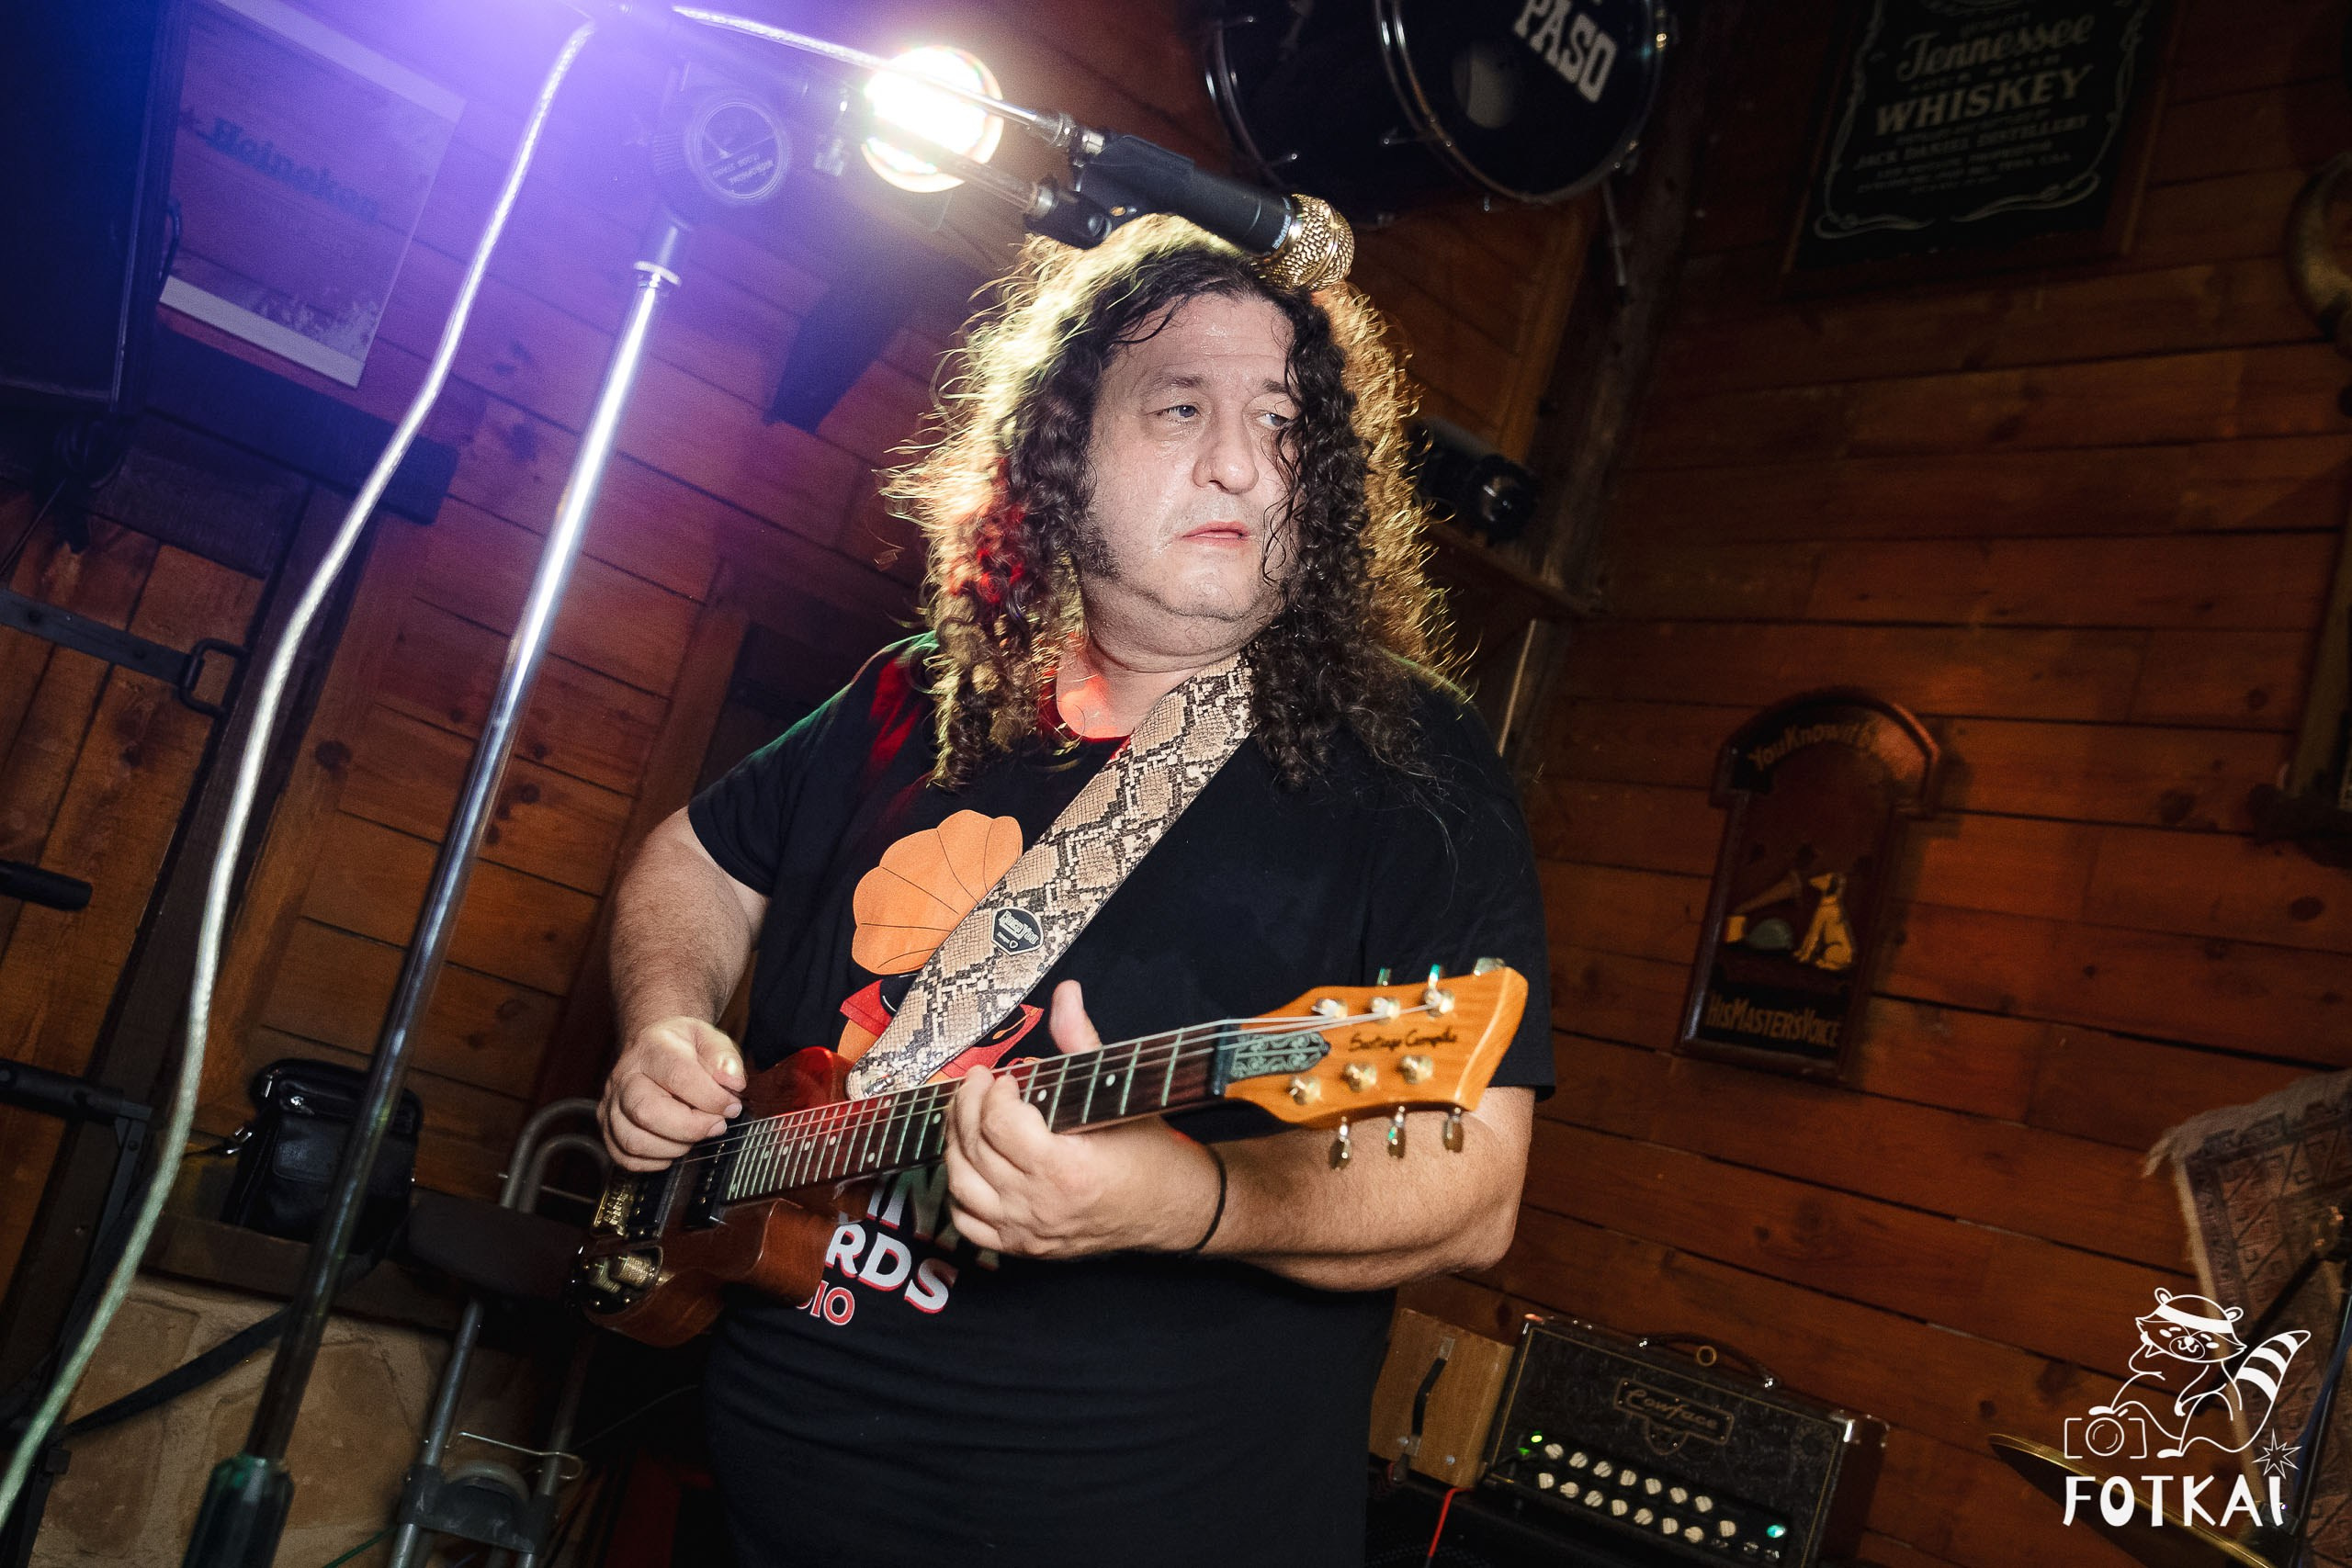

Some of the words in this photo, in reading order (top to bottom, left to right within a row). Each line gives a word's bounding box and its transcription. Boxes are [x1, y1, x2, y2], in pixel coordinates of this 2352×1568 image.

[1513, 0, 1617, 103] PASO
[1897, 14, 2096, 82] Tennessee
[1875, 63, 2095, 137] WHISKEY
[796, 1280, 855, 1325] IO
[824, 1224, 959, 1314] RDS
